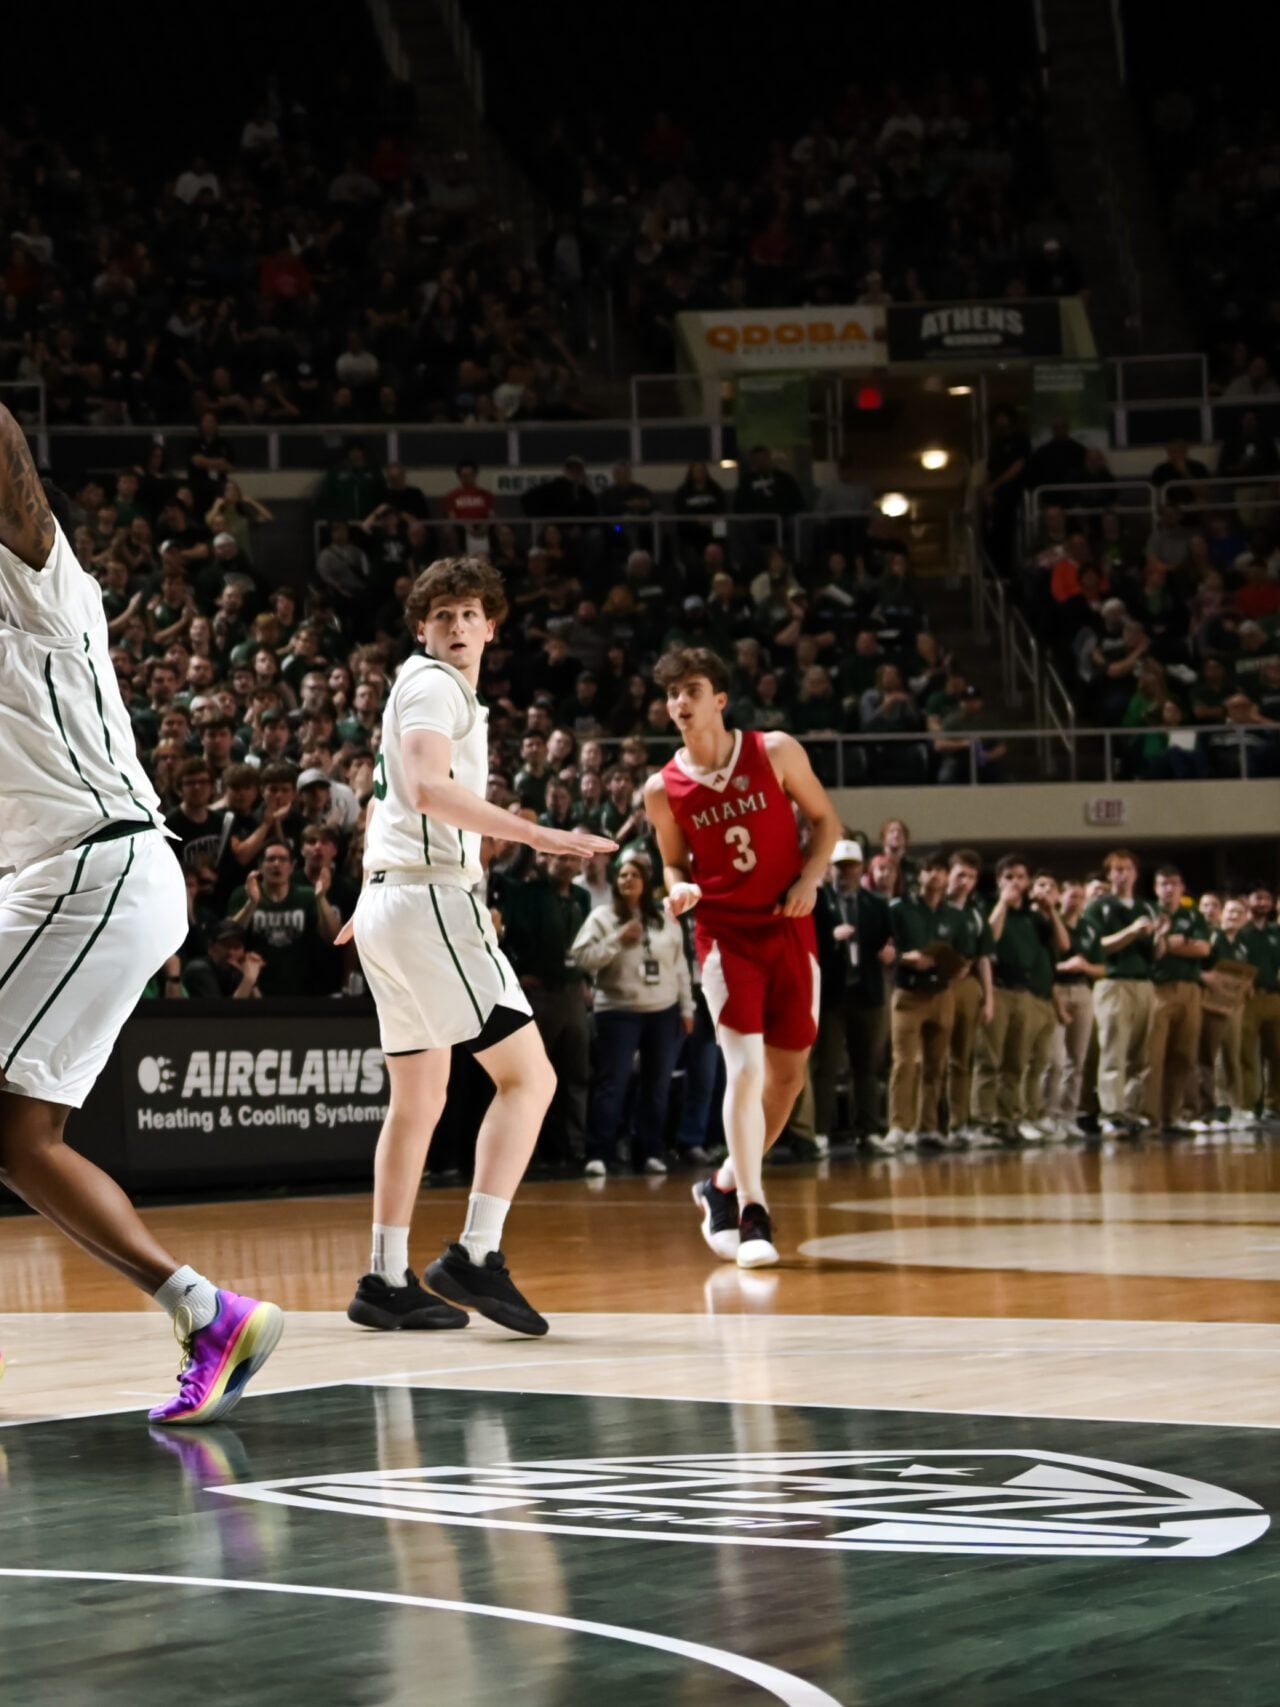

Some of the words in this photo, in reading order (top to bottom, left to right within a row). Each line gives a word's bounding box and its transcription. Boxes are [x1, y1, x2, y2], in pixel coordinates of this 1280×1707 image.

[705, 321, 869, 354] QDOBA
[920, 306, 1024, 340] ATHENS
[690, 791, 768, 831] MIAMI
[724, 825, 758, 873] 3
[180, 1048, 385, 1099] AIRCLAWS
[137, 1107, 214, 1133] Heating
[219, 1105, 233, 1127] &
[237, 1104, 310, 1130] Cooling
